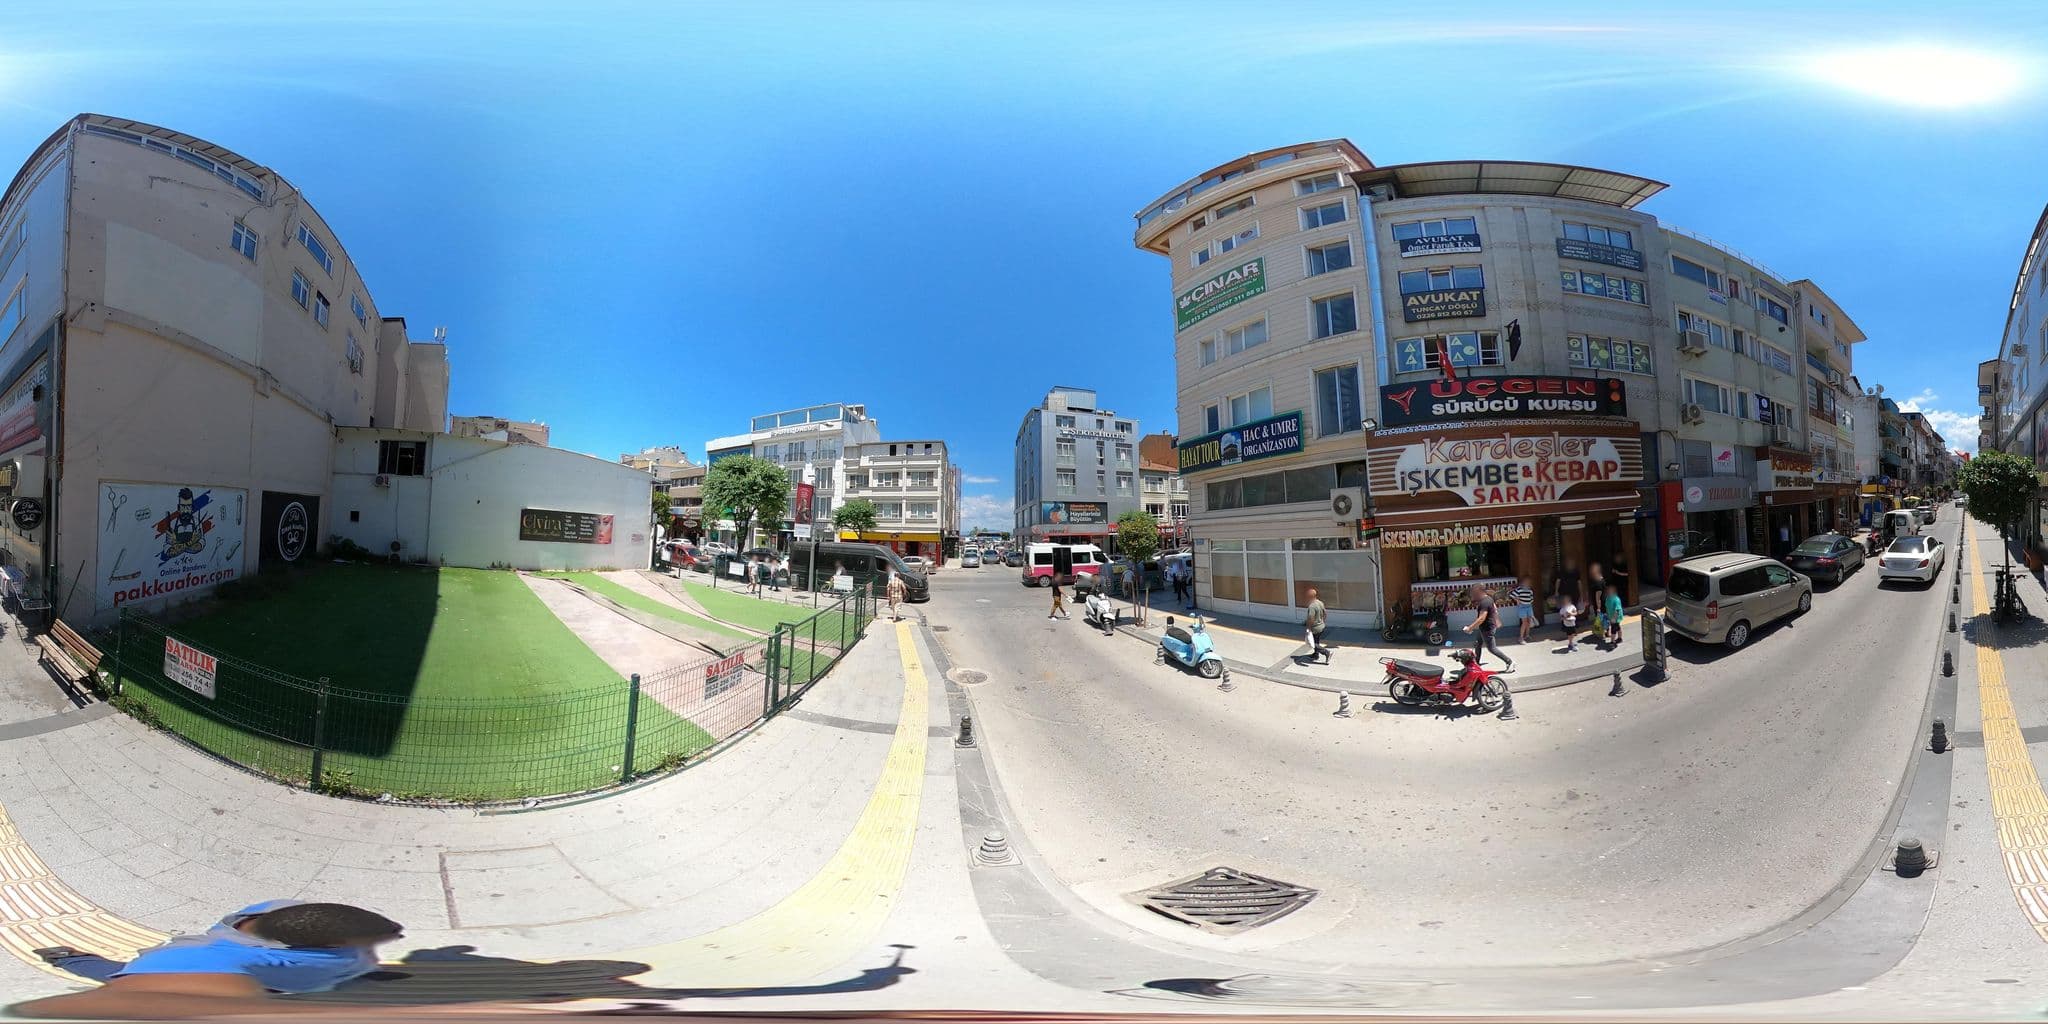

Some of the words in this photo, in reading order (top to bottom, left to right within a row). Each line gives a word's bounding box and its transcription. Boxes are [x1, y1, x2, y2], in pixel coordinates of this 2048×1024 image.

[1415, 235, 1464, 244] AVUKAT
[1191, 262, 1259, 302] ÇINAR
[1407, 291, 1480, 306] AVUKAT
[1412, 305, 1446, 313] TUNCAY
[1430, 379, 1597, 397] ÜÇGEN
[1431, 396, 1518, 416] SÜRÜCÜ
[1528, 398, 1597, 412] KURSU
[1243, 427, 1261, 442] HAC
[1262, 425, 1269, 437] &
[1271, 418, 1298, 436] UMRE
[1181, 445, 1200, 468] HAYAT
[1200, 440, 1220, 463] TOUR
[1243, 435, 1299, 457] ORGANİZASYON
[1422, 432, 1597, 465] Kardeşler
[1522, 465, 1533, 478] &
[1537, 460, 1618, 481] KEBAP
[1473, 484, 1556, 505] SARAYI
[1492, 522, 1533, 542] KEBAP
[160, 568, 181, 577] Online
[113, 567, 234, 608] pakkuafor.com
[167, 639, 215, 674] SATILIK
[706, 651, 745, 678] SATILIK
